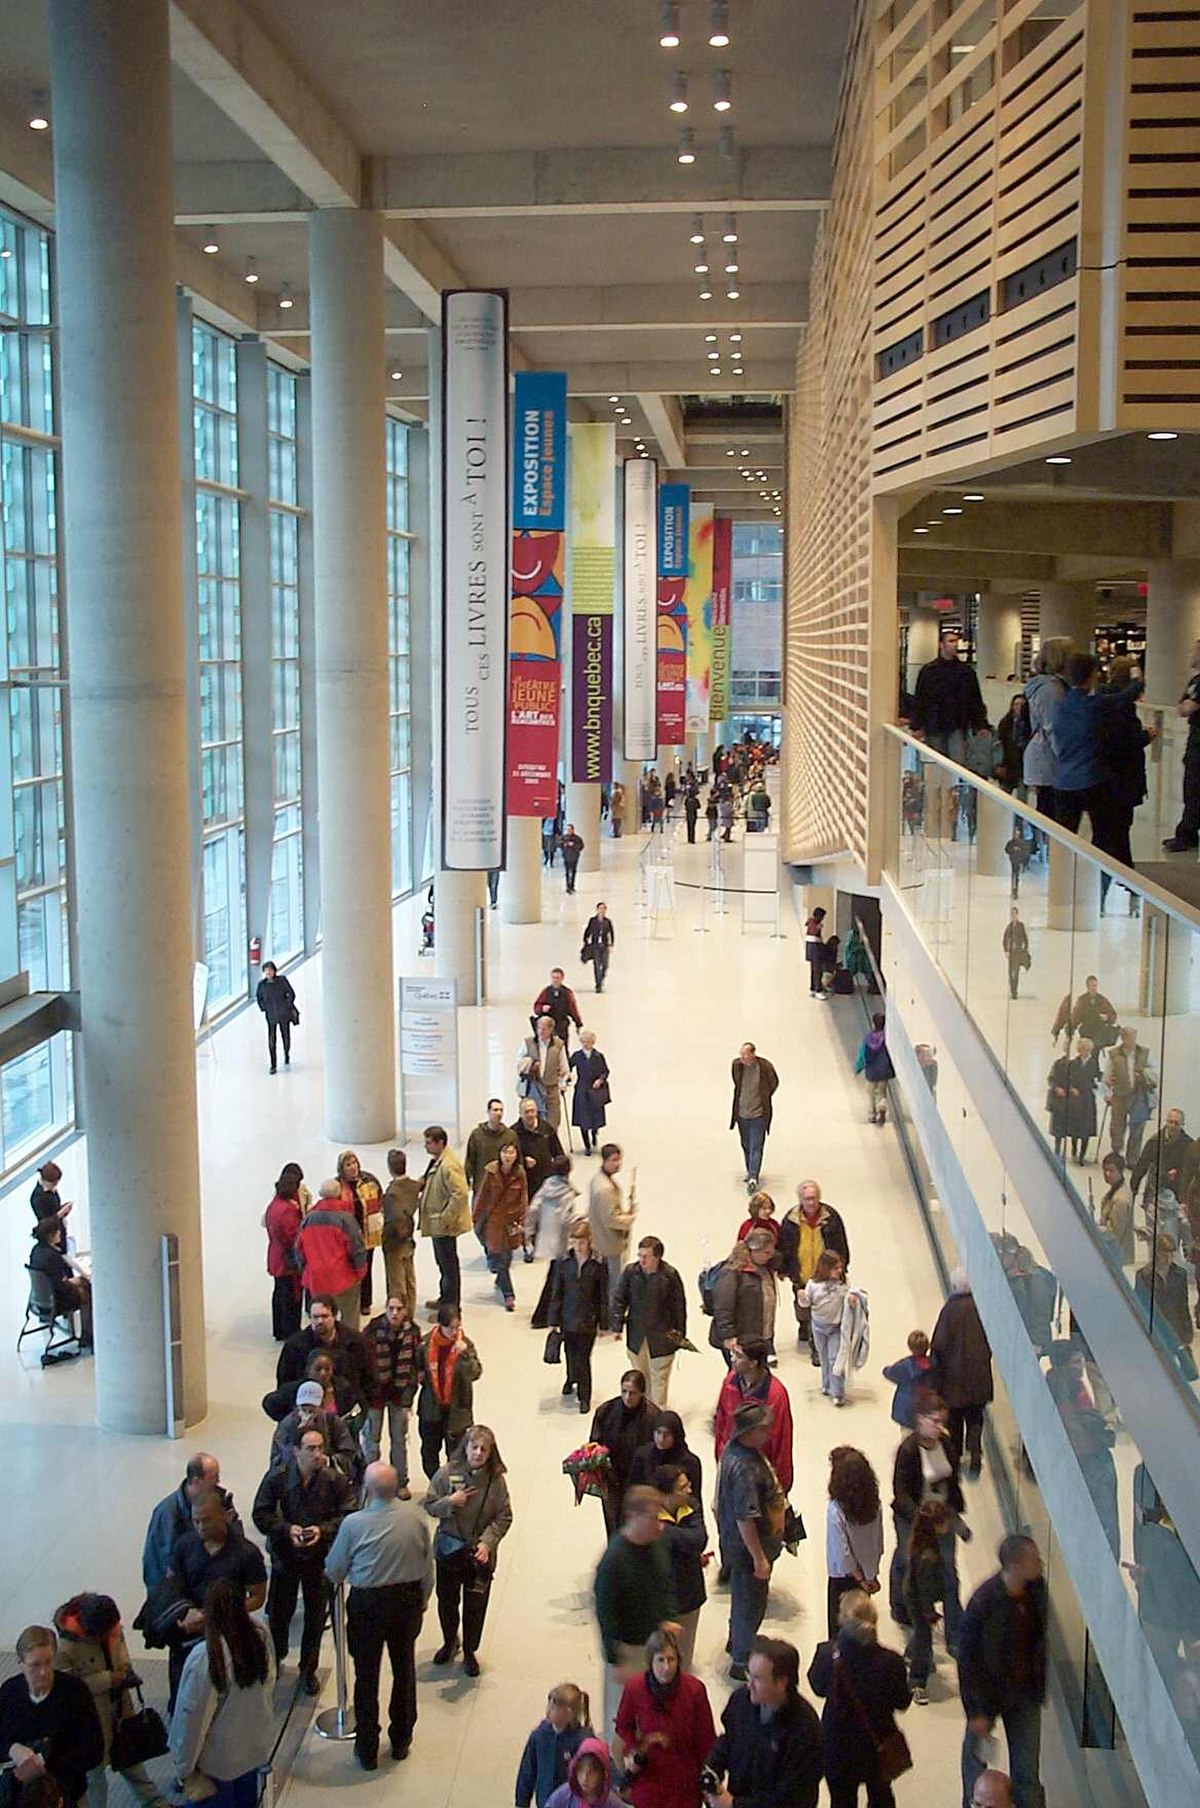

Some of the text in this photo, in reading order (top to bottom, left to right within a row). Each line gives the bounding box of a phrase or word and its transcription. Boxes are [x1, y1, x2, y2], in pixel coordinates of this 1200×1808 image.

[523, 410, 540, 516] EXPOSITION
[471, 511, 484, 551] SONT
[664, 506, 674, 568] EXPOSITION
[468, 560, 487, 646] LIVRES
[479, 653, 490, 681] CES
[512, 690, 556, 702] JEUNE
[582, 616, 607, 779] www.bnquebec.ca
[709, 625, 726, 720] Bienvenue
[465, 686, 479, 735] TOUS
